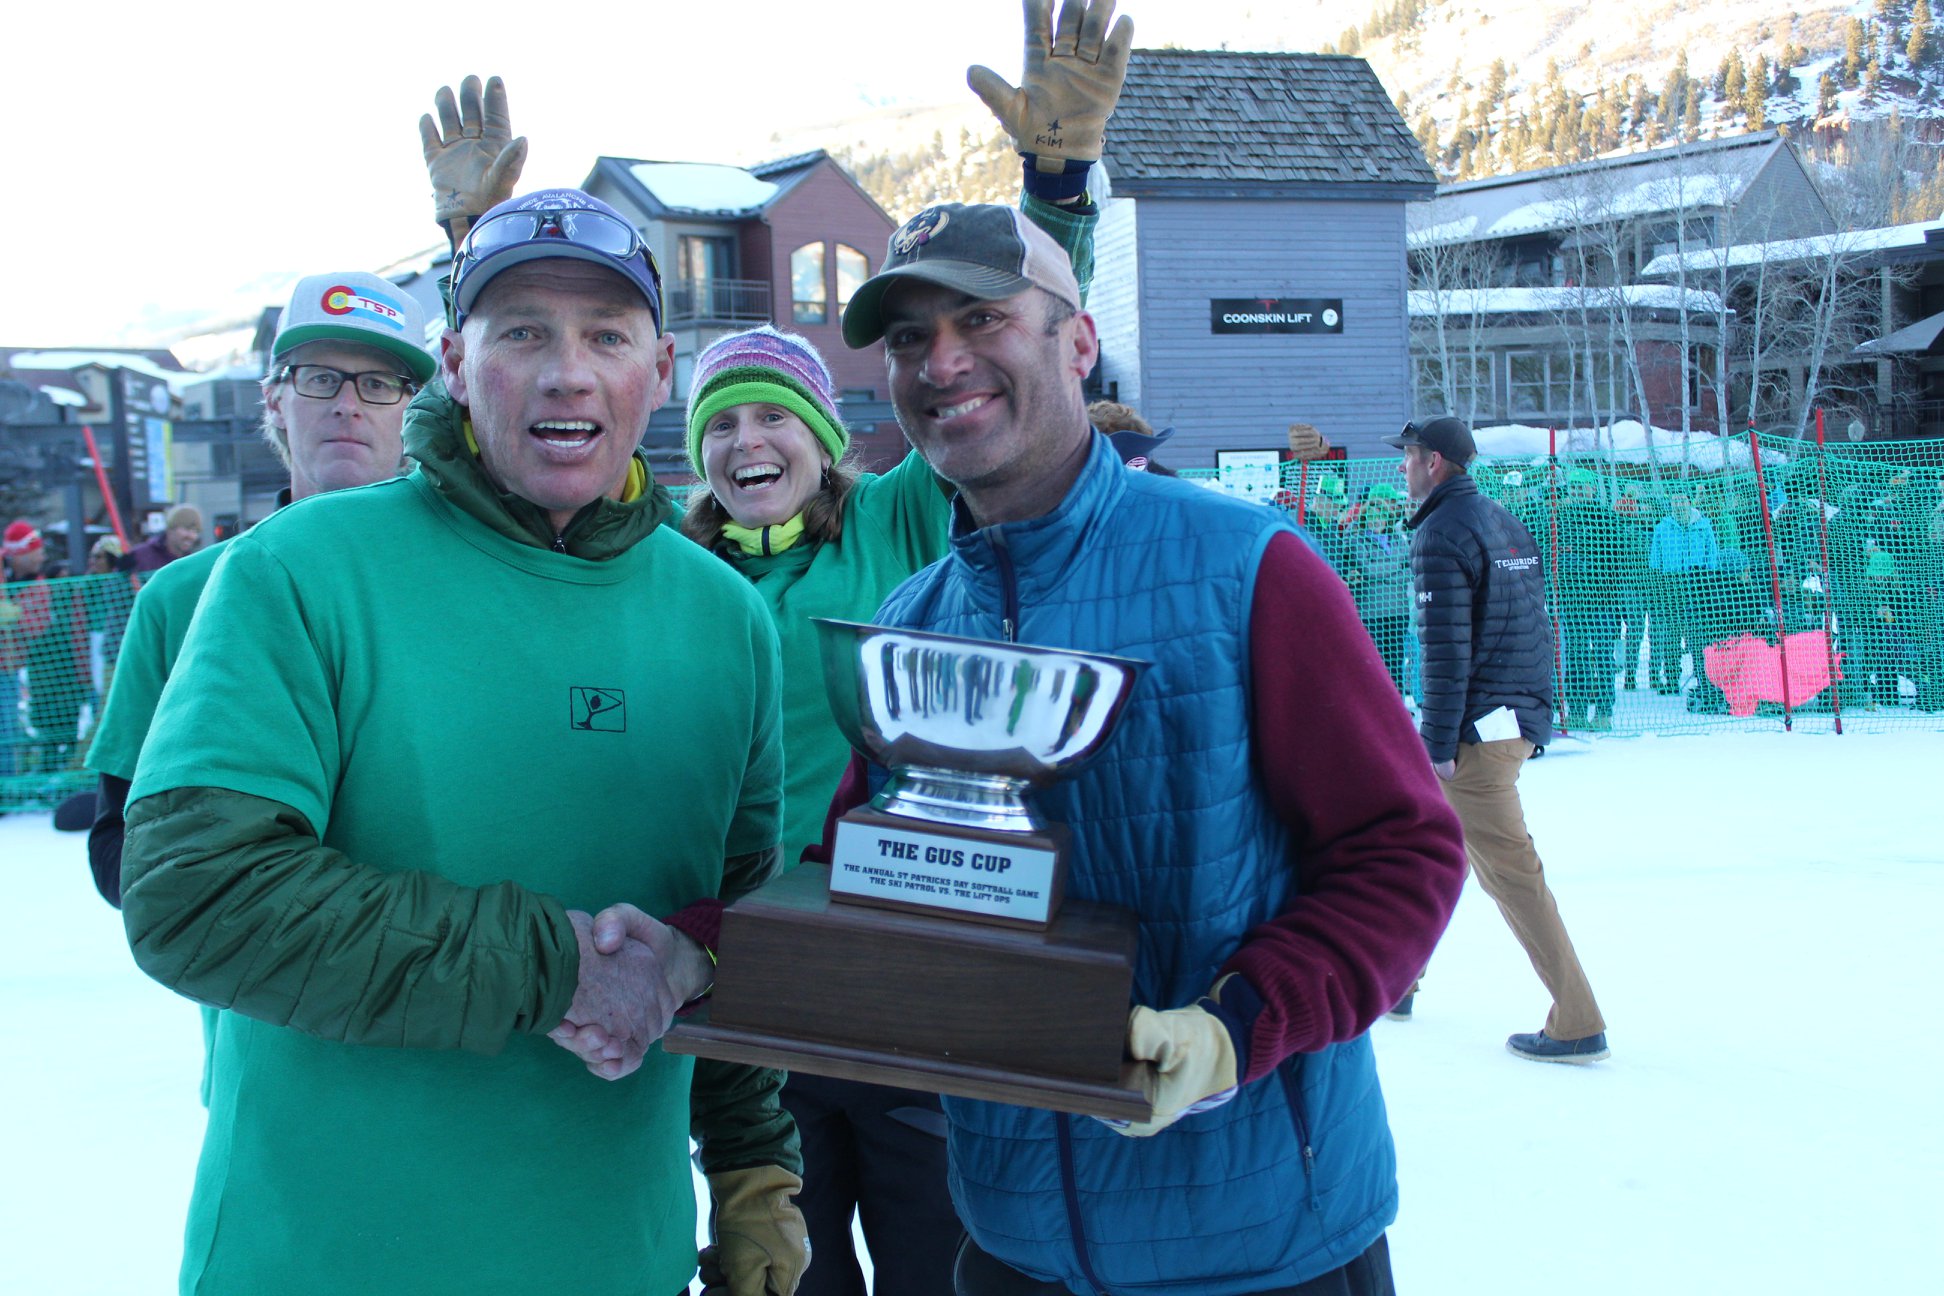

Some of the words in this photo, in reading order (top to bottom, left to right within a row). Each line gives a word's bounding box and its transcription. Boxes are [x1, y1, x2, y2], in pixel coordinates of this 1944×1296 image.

[1035, 134, 1063, 149] KIM
[541, 192, 587, 206] AVALANCHE
[357, 297, 396, 317] TSP
[1222, 313, 1285, 324] COONSKIN
[1287, 313, 1312, 324] LIFT
[1494, 556, 1539, 569] TELLURIDE
[878, 839, 919, 861] THE
[924, 846, 965, 868] GUS
[971, 852, 1012, 874] CUP
[844, 864, 860, 872] THE
[862, 866, 895, 878] ANNUAL
[897, 871, 909, 880] ST
[911, 873, 951, 886] PATRICKS
[953, 879, 969, 888] DAY
[971, 882, 1014, 895] SOFTBALL
[1016, 889, 1039, 899] GAME
[869, 876, 886, 885] THE
[888, 879, 902, 888] SKI
[904, 881, 936, 894] PATROL
[954, 889, 971, 898] THE
[973, 891, 992, 901] LIFT
[994, 895, 1011, 904] OPS
